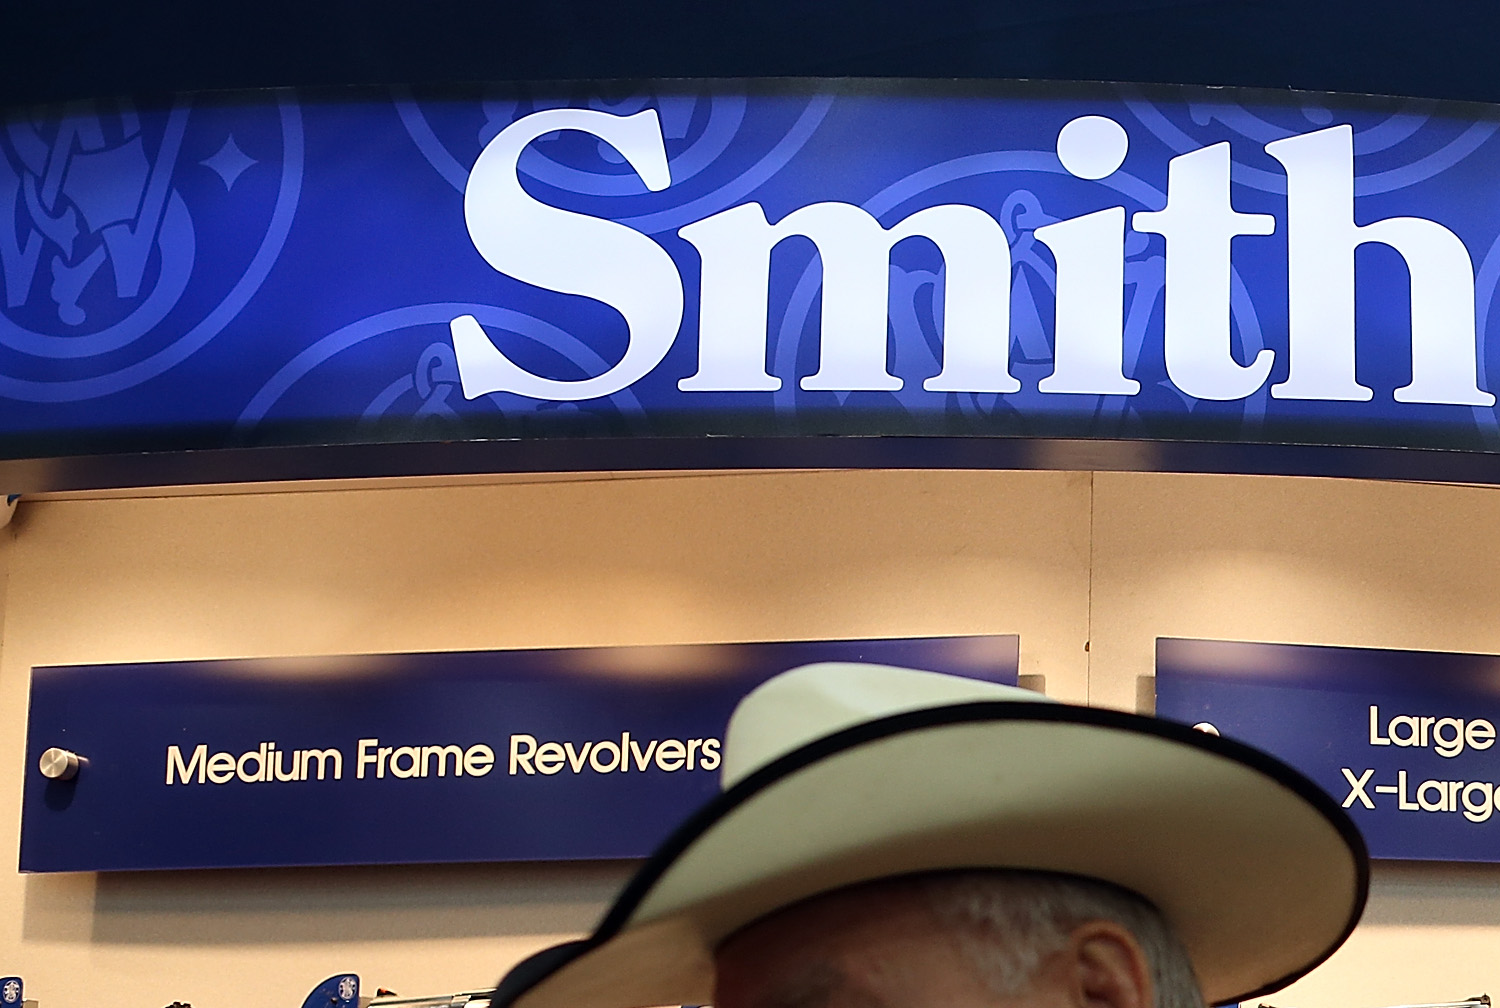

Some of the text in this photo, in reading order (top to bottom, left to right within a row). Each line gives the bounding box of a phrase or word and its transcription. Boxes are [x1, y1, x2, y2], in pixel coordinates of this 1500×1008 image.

[449, 108, 1497, 407] Smith
[165, 731, 722, 785] Medium Frame Revolvers
[1369, 705, 1496, 758] Large
